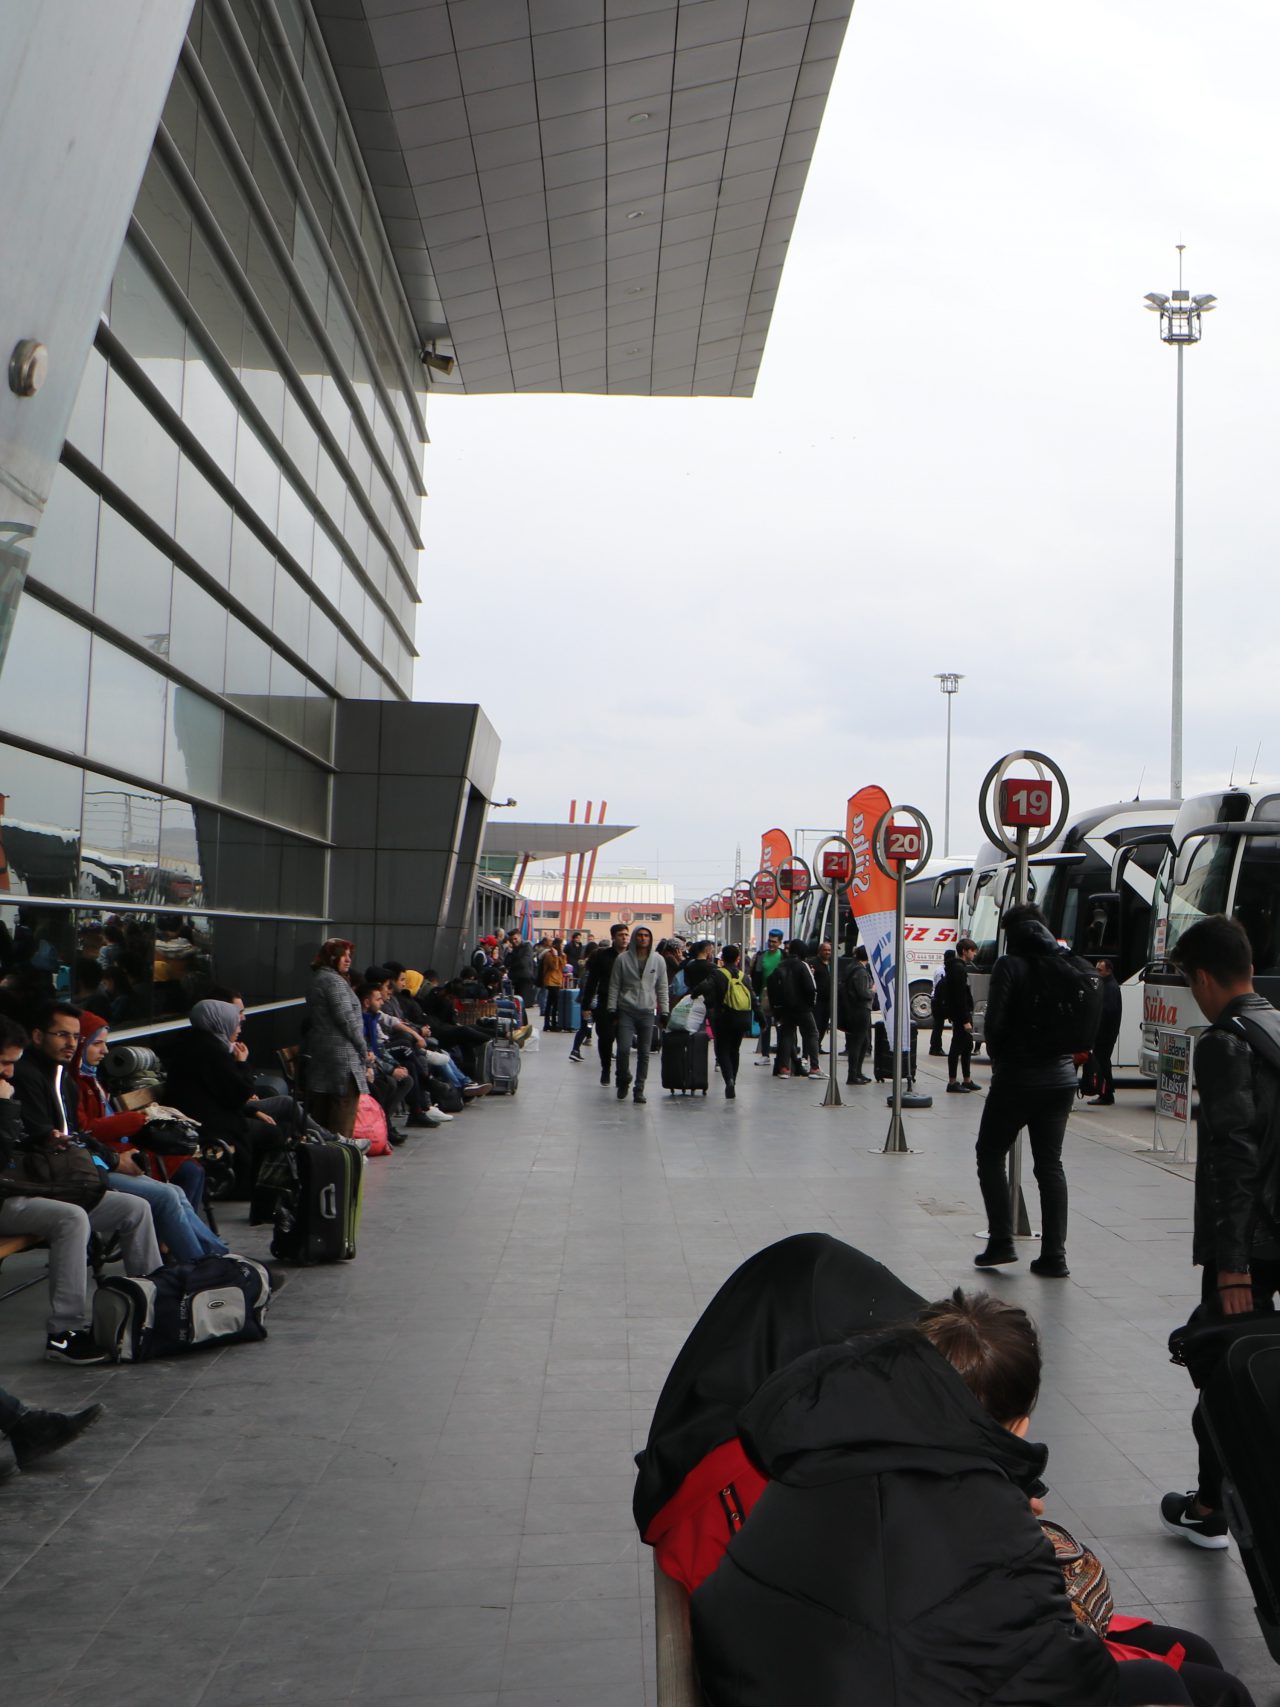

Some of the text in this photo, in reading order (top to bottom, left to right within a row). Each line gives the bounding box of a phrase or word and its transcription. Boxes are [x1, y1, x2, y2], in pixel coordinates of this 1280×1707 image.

[1012, 789, 1048, 816] 19
[889, 833, 919, 853] 20
[827, 855, 848, 870] 21
[758, 885, 774, 896] 23
[1144, 995, 1178, 1025] Süha
